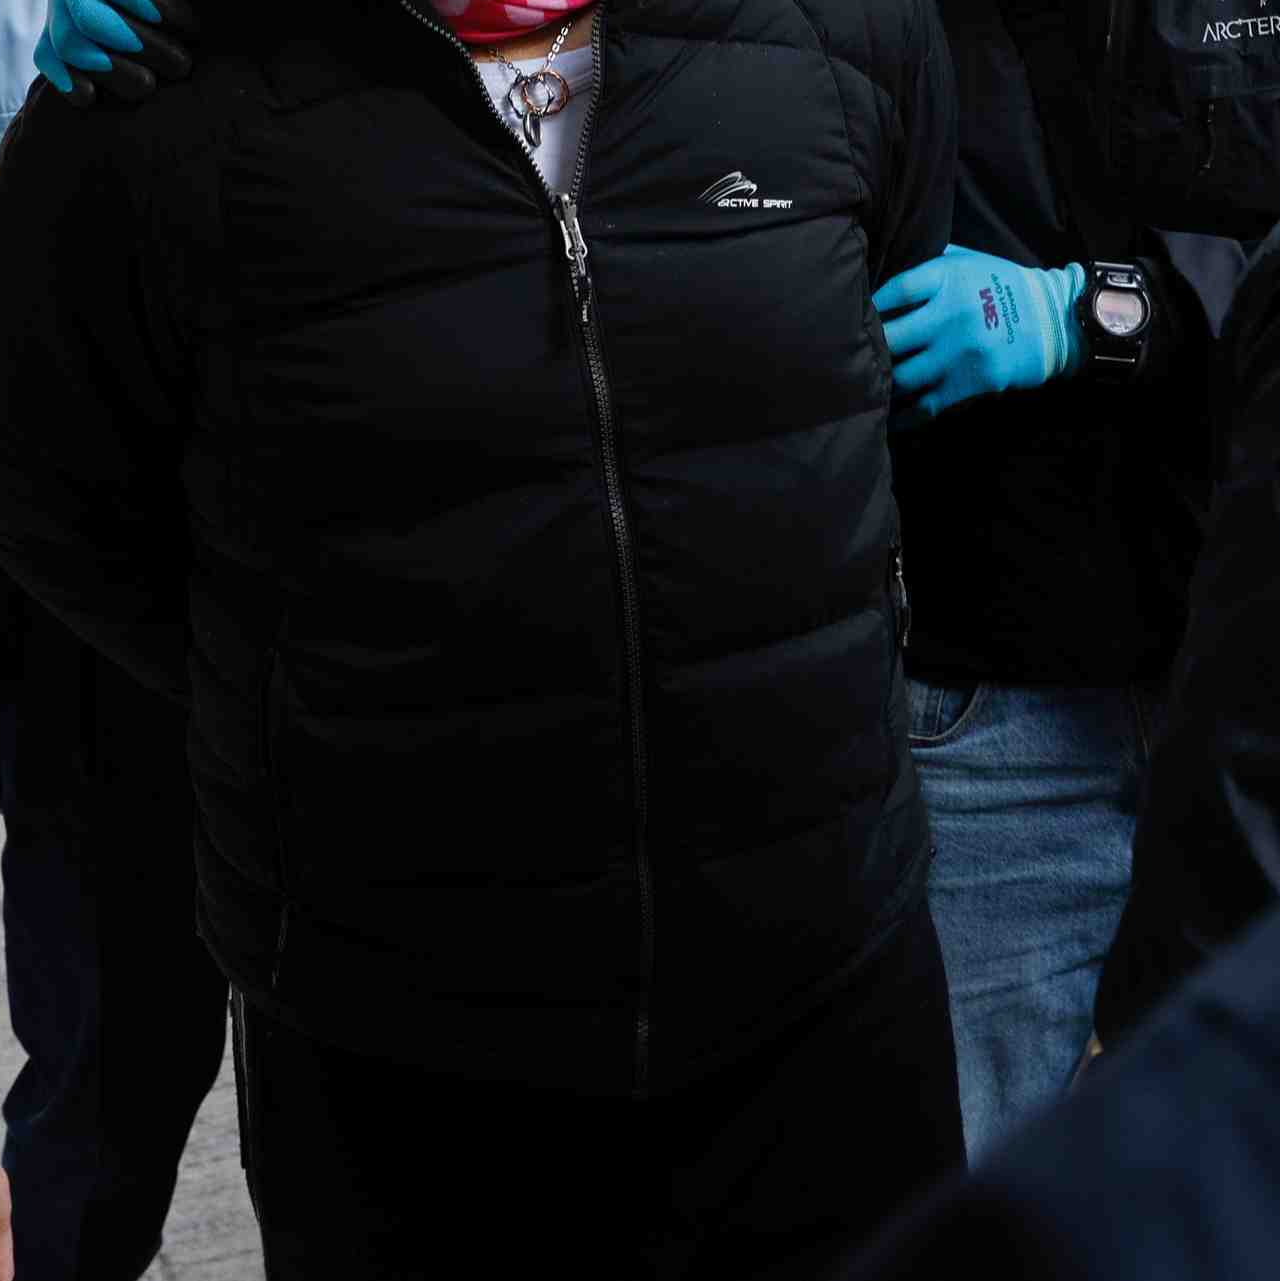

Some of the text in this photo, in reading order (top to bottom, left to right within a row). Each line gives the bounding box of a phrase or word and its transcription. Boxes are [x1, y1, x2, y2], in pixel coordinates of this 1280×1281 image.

[763, 199, 793, 209] SPIRIT
[979, 287, 999, 331] 3M
[999, 295, 1015, 345] Comfort
[1004, 285, 1020, 324] Gloves
